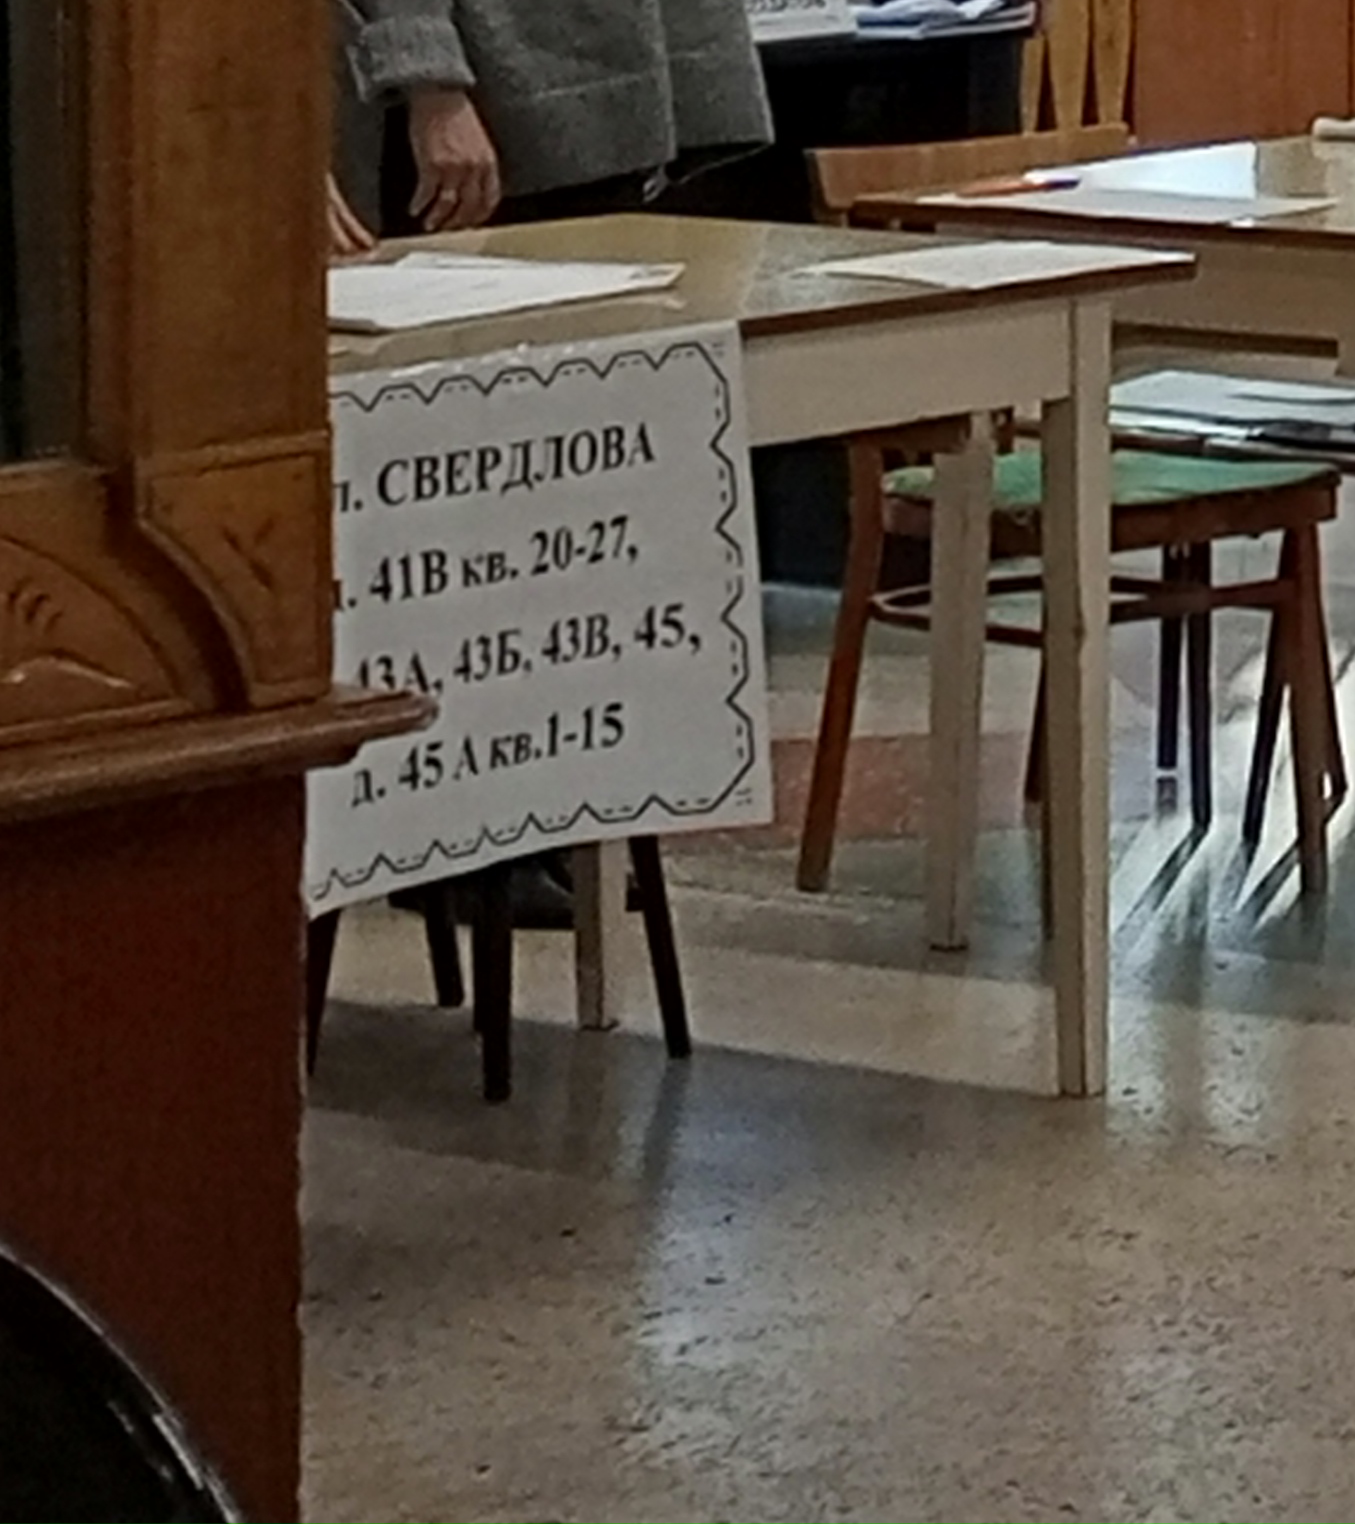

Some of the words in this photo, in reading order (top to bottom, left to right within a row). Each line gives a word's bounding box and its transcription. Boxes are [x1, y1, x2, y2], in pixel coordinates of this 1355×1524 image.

[377, 421, 656, 507] СВЕРДЛОВА
[369, 548, 449, 604] 41В
[460, 552, 519, 588] кв.
[529, 515, 638, 575] 20-27,
[541, 612, 622, 666] 43В,
[634, 602, 701, 656] 45,
[351, 770, 386, 808] д.
